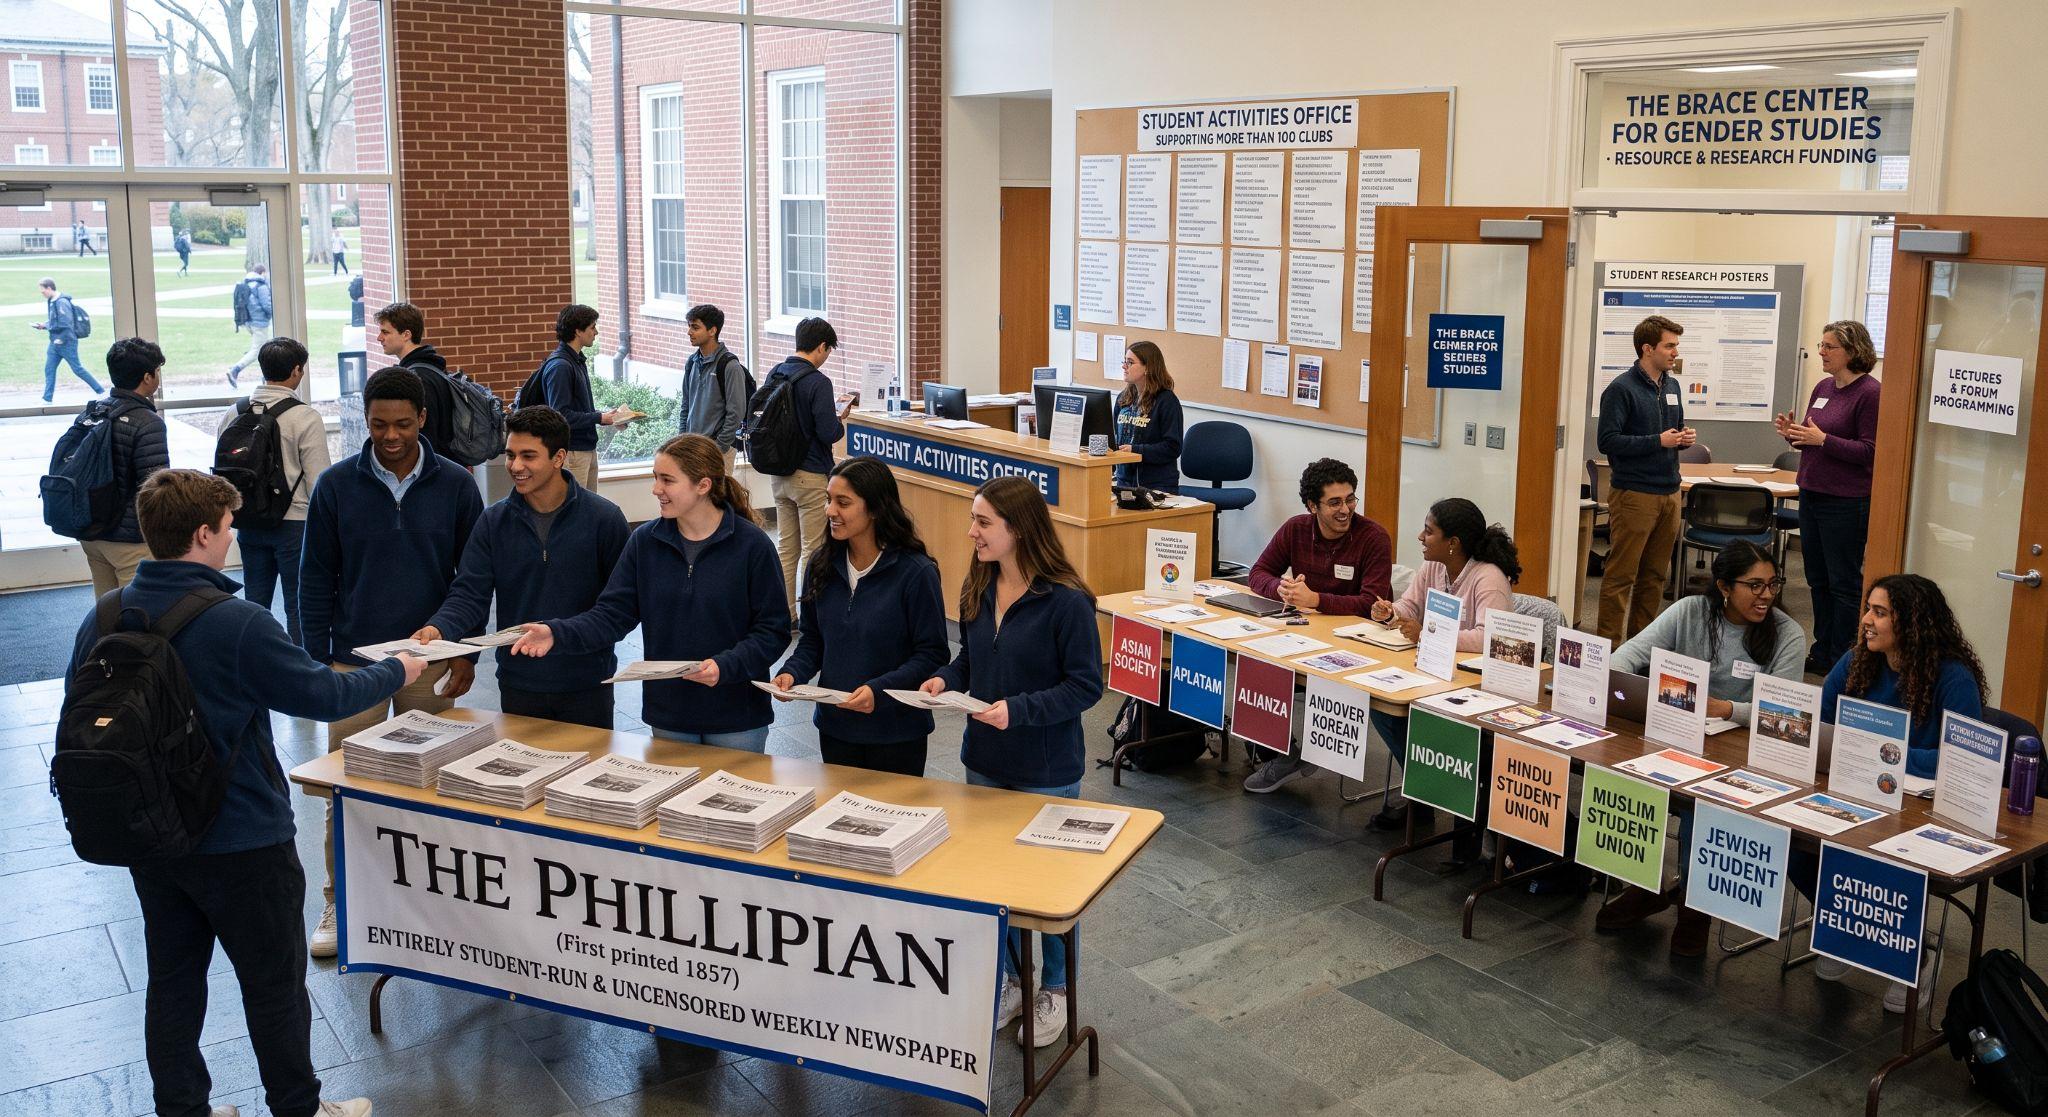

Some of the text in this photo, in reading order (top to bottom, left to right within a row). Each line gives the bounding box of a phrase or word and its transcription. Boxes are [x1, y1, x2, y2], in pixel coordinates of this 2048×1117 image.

[1626, 87, 1869, 117] THE BRACE CENTER
[1143, 105, 1352, 130] STUDENT ACTIVITIES OFFICE
[1613, 116, 1882, 144] FOR GENDER STUDIES
[1156, 130, 1333, 146] SUPPORTING MORE THAN 100 CLUBS
[1615, 148, 1877, 165] RESOURCE & RESEARCH FUNDING
[1610, 270, 1768, 282] STUDENT RESEARCH POSTERS
[1436, 329, 1495, 339] THE BRACE
[1476, 342, 1498, 351] FOR
[1443, 364, 1487, 375] STUDIES
[1949, 368, 2002, 385] LECTURES
[1934, 395, 2014, 416] PROGRAMMING
[1950, 383, 1998, 399] & FORUM
[853, 432, 911, 462] STUDENT
[914, 445, 988, 480] ACTIVITIES
[1121, 638, 1151, 660] ASIAN
[1114, 652, 1157, 679] SOCIETY
[1173, 666, 1222, 695] APLATAM
[1238, 688, 1287, 718] ALIANZA
[1309, 694, 1364, 724] ANDOVER
[1312, 713, 1359, 741] KOREAN
[1310, 731, 1359, 759] SOCIETY
[1411, 743, 1473, 780] INDOPAK
[1507, 758, 1552, 786] HINDU
[717, 775, 738, 786] THE
[1497, 775, 1561, 810] STUDENT
[841, 796, 862, 807] THE
[1505, 798, 1549, 828] UNION
[1593, 787, 1655, 822] MUSLIM
[1587, 807, 1659, 844] STUDENT
[1596, 831, 1645, 863] UNION
[1706, 827, 1771, 863] JEWISH
[1698, 847, 1778, 888] STUDENT
[1708, 873, 1762, 908] UNION
[1833, 874, 1908, 910] CATHOLIC
[376, 826, 954, 995] THE PHILLIPIAN
[1833, 894, 1904, 929] STUDENT
[1819, 909, 1916, 953] FELLOWSHIP
[557, 932, 739, 991] (First printed 1857)
[367, 926, 977, 1075] ENTIRELY STUDENT-RUN & UNCENSORED WEEKLY NEWSPAPER
